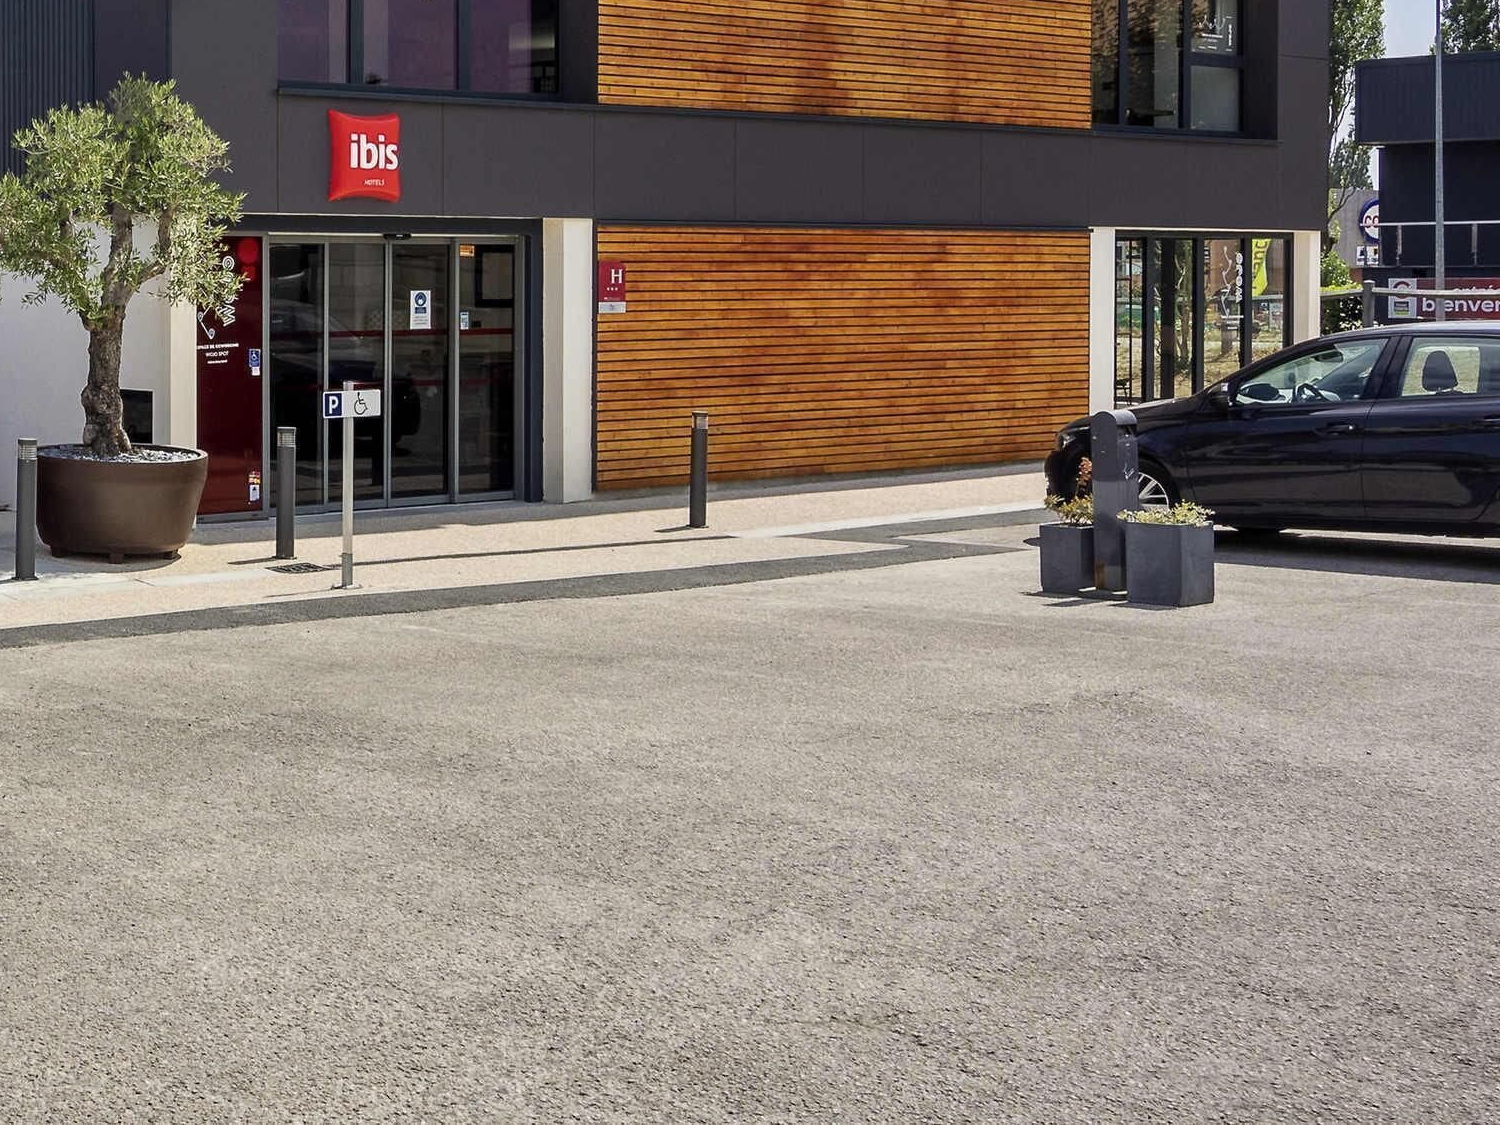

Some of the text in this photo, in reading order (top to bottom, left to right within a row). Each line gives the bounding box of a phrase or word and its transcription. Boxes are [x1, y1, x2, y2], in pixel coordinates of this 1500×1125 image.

[350, 133, 399, 171] ibis
[364, 178, 385, 186] HOTELS
[611, 268, 623, 284] H
[1422, 297, 1500, 312] benve
[329, 395, 339, 414] P
